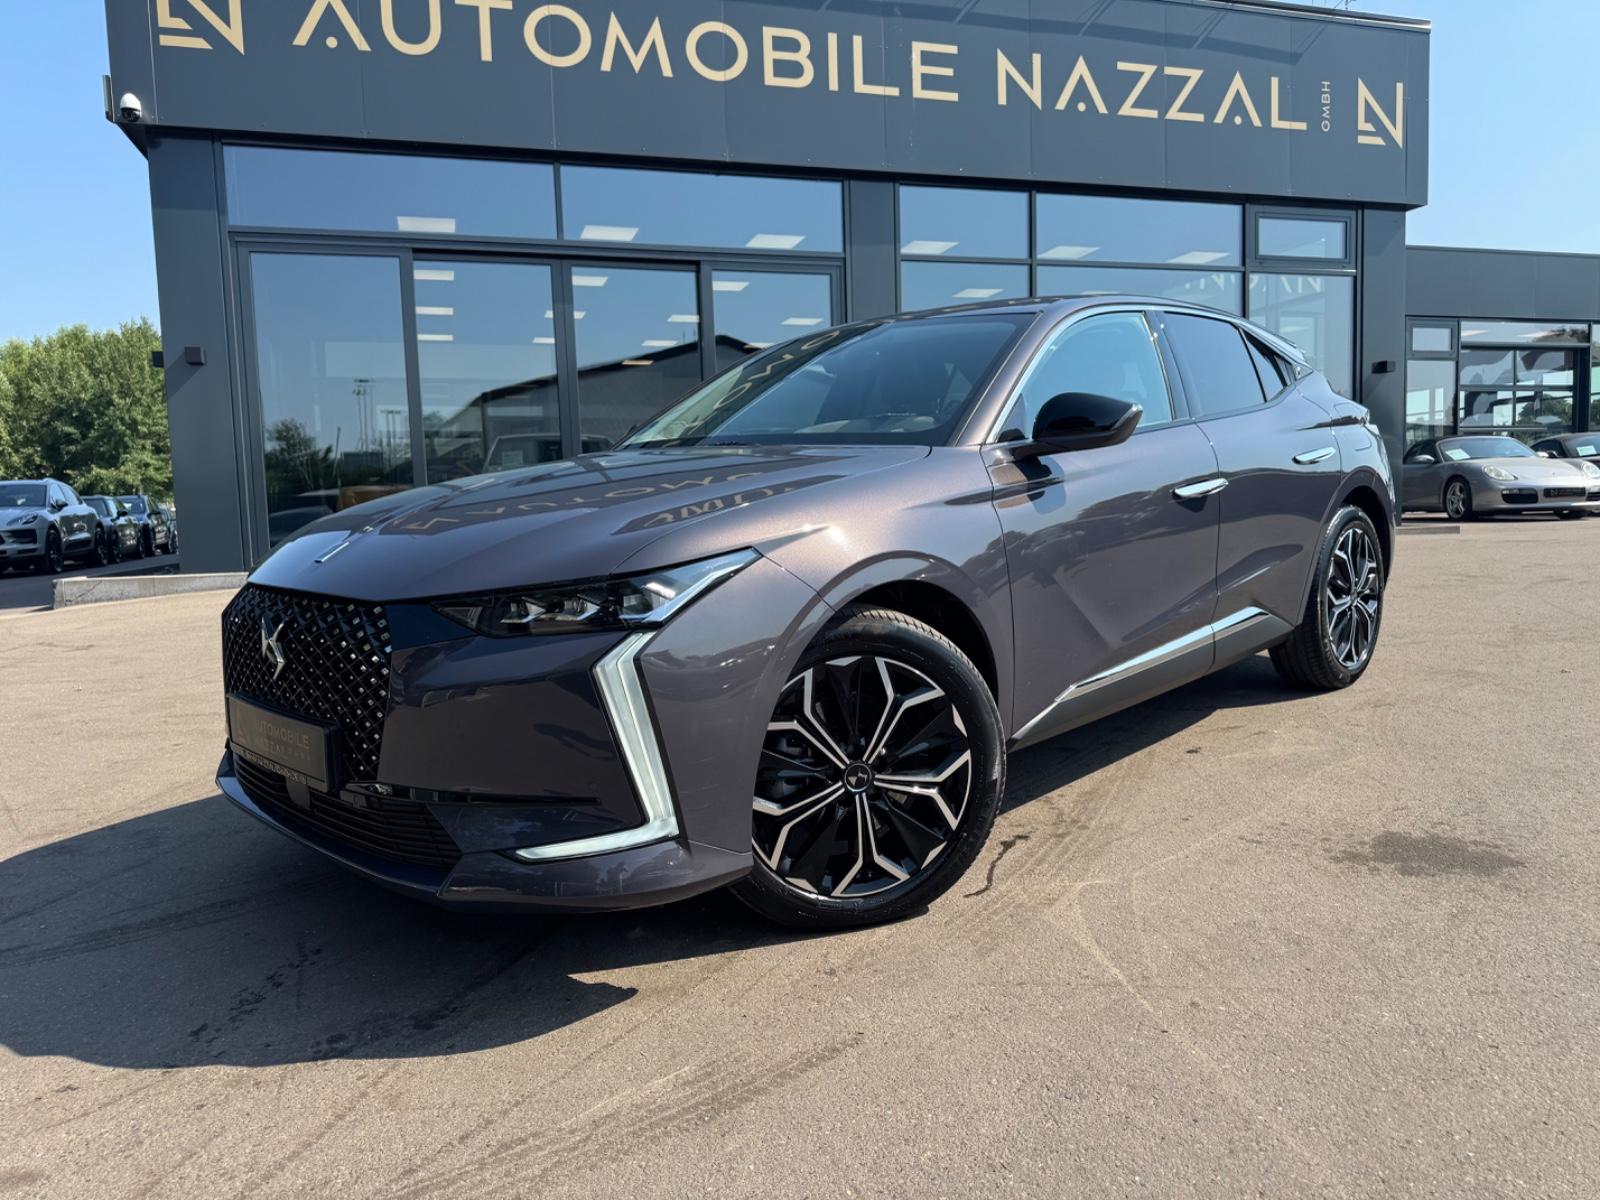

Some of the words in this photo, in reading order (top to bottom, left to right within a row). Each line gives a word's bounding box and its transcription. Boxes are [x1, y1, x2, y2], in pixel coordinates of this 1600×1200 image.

[292, 0, 959, 103] AUTOMOBILE
[996, 48, 1308, 131] NAZZAL
[1320, 80, 1331, 133] GMBH
